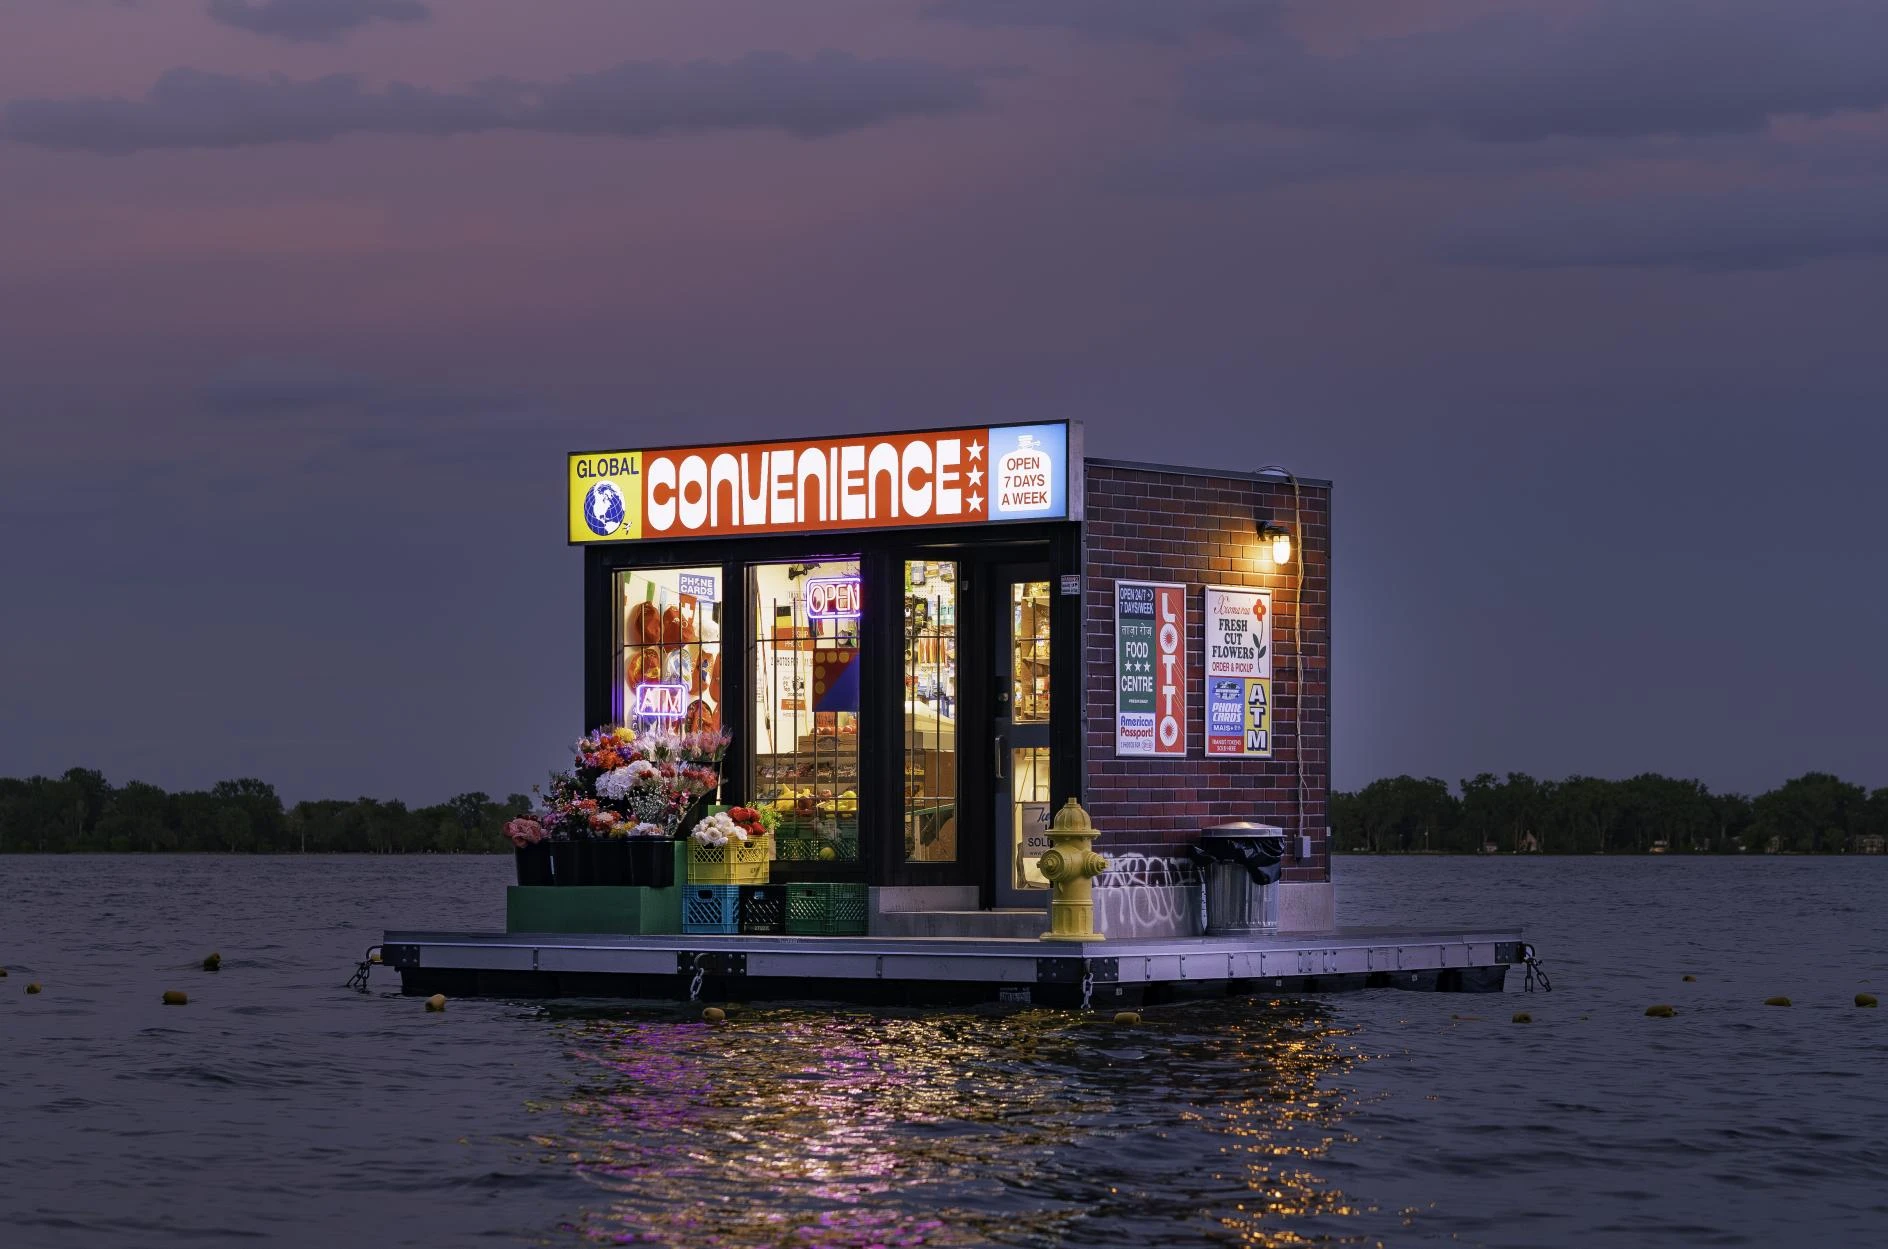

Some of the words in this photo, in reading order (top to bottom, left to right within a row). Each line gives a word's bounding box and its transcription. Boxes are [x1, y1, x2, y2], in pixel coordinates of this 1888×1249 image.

[576, 456, 639, 479] GLOBAL
[1006, 457, 1040, 471] OPEN
[647, 438, 962, 531] CONVENIENCE
[1004, 476, 1011, 488] 7
[1013, 474, 1045, 488] DAYS
[1001, 493, 1010, 506] A
[1012, 491, 1048, 505] WEEK
[680, 584, 714, 596] CARDS
[1120, 587, 1135, 601] OPEN
[1135, 588, 1147, 601] 24/7
[809, 583, 860, 613] OPEN
[1119, 601, 1124, 614] 7
[1124, 602, 1154, 615] DAYS/WEEK
[1218, 618, 1248, 632] FRESH
[1224, 632, 1243, 646] CUT
[1125, 641, 1149, 658] FOOD
[1212, 645, 1255, 660] FLOWERS
[1159, 592, 1178, 747] LOTTO
[1212, 661, 1230, 672] ORDER
[1230, 663, 1235, 673] &
[1235, 663, 1254, 673] PICKUP
[1121, 675, 1153, 693] CENTRE
[1211, 702, 1243, 713] PHONE
[1120, 715, 1154, 727] American
[1212, 712, 1243, 723] CARDS
[1247, 683, 1268, 751] ATM
